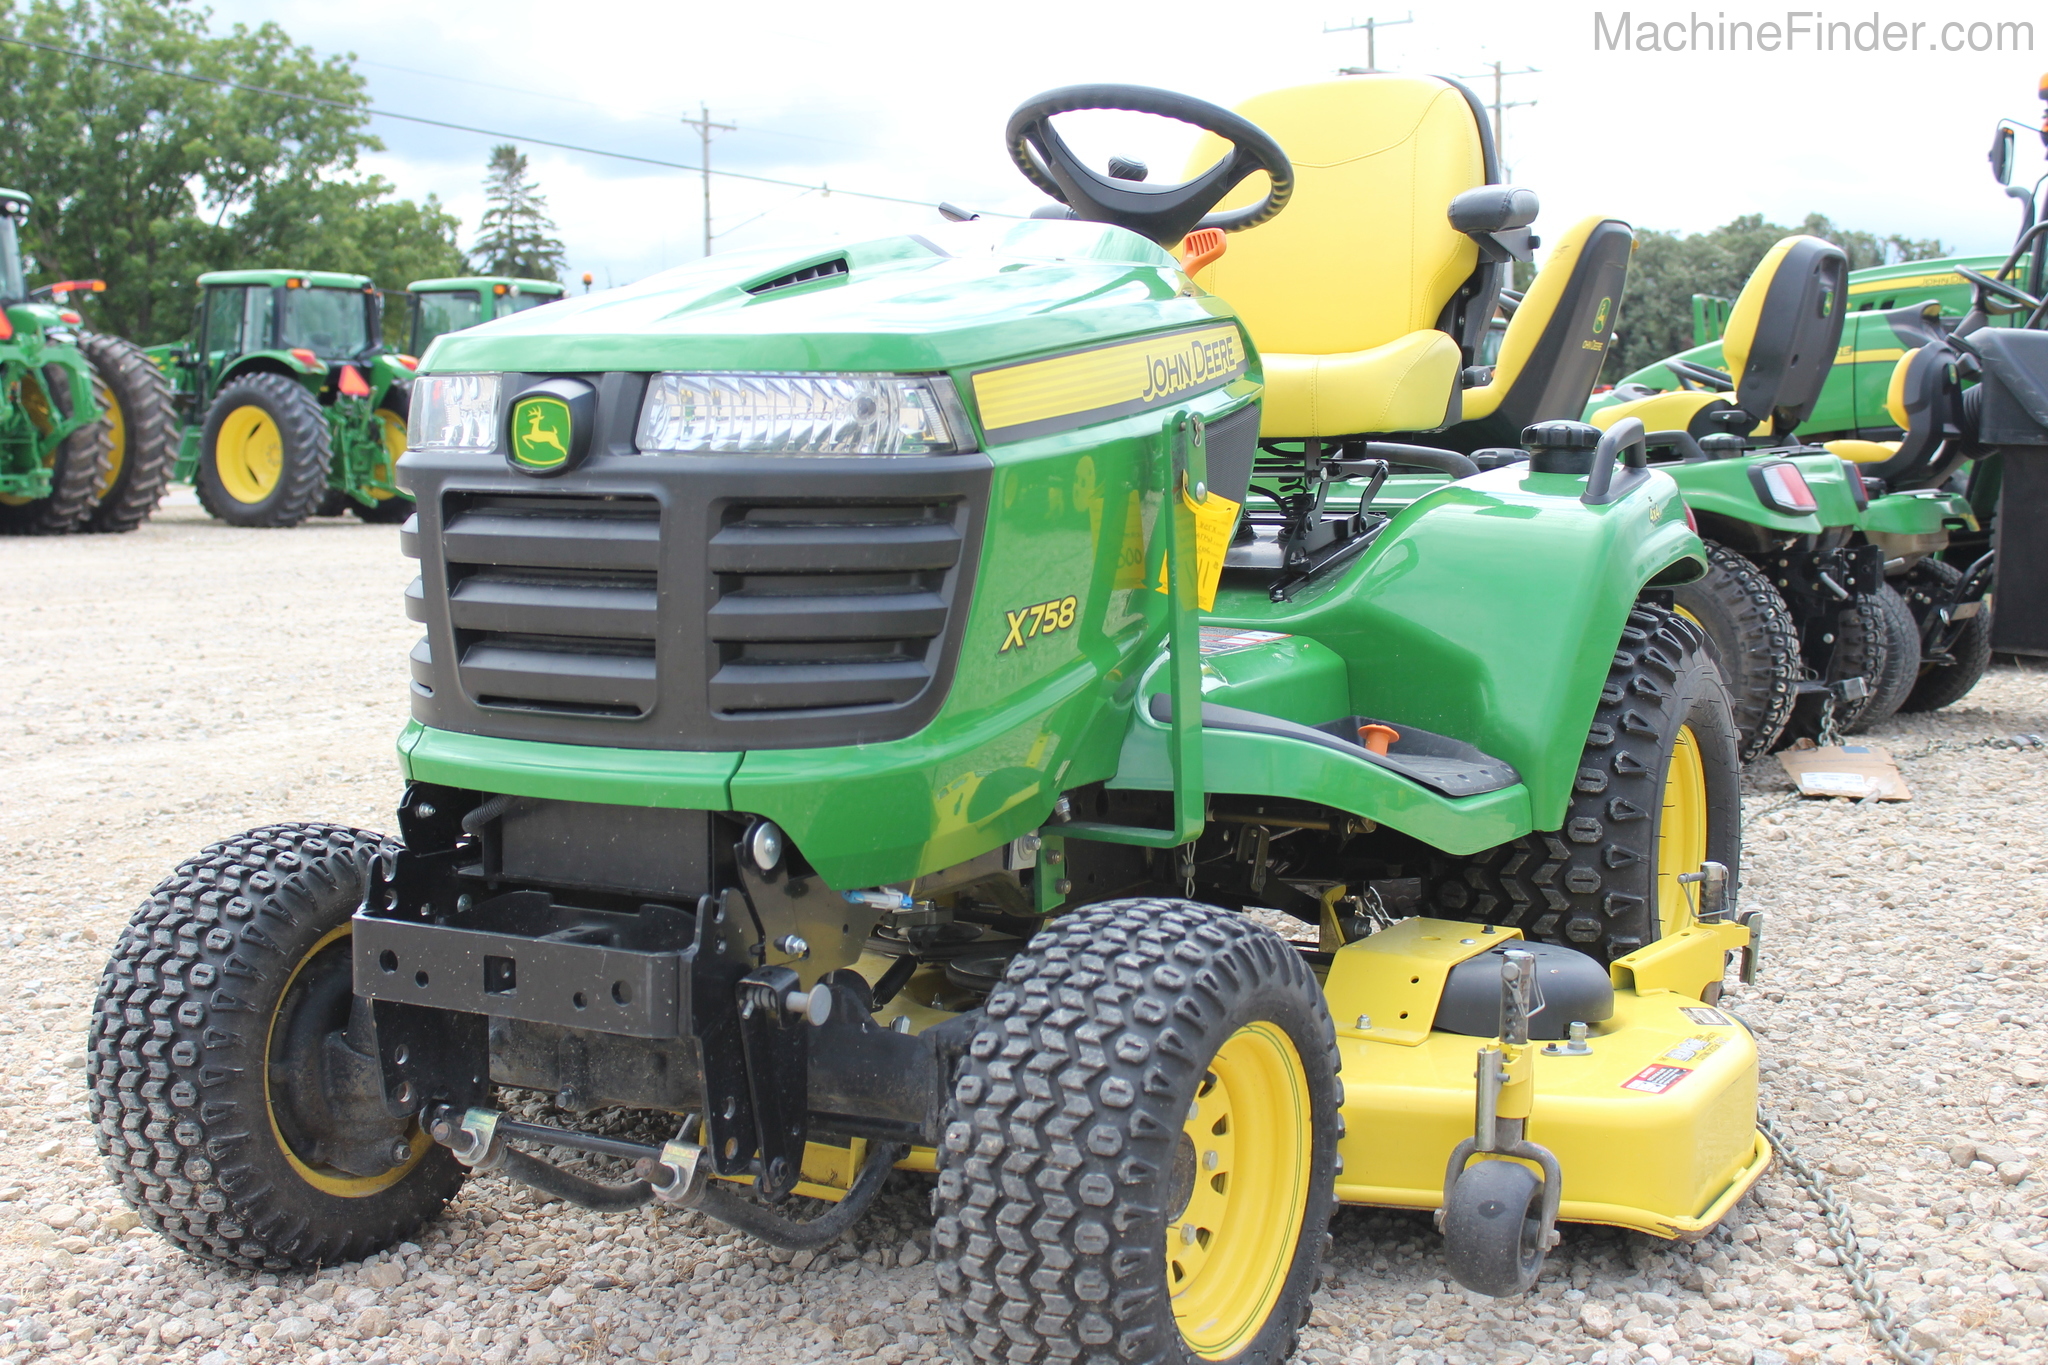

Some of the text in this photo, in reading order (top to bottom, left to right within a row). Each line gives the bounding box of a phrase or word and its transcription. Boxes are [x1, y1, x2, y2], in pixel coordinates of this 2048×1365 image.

[1143, 336, 1237, 401] JOHN DEERE
[998, 595, 1077, 654] X758
